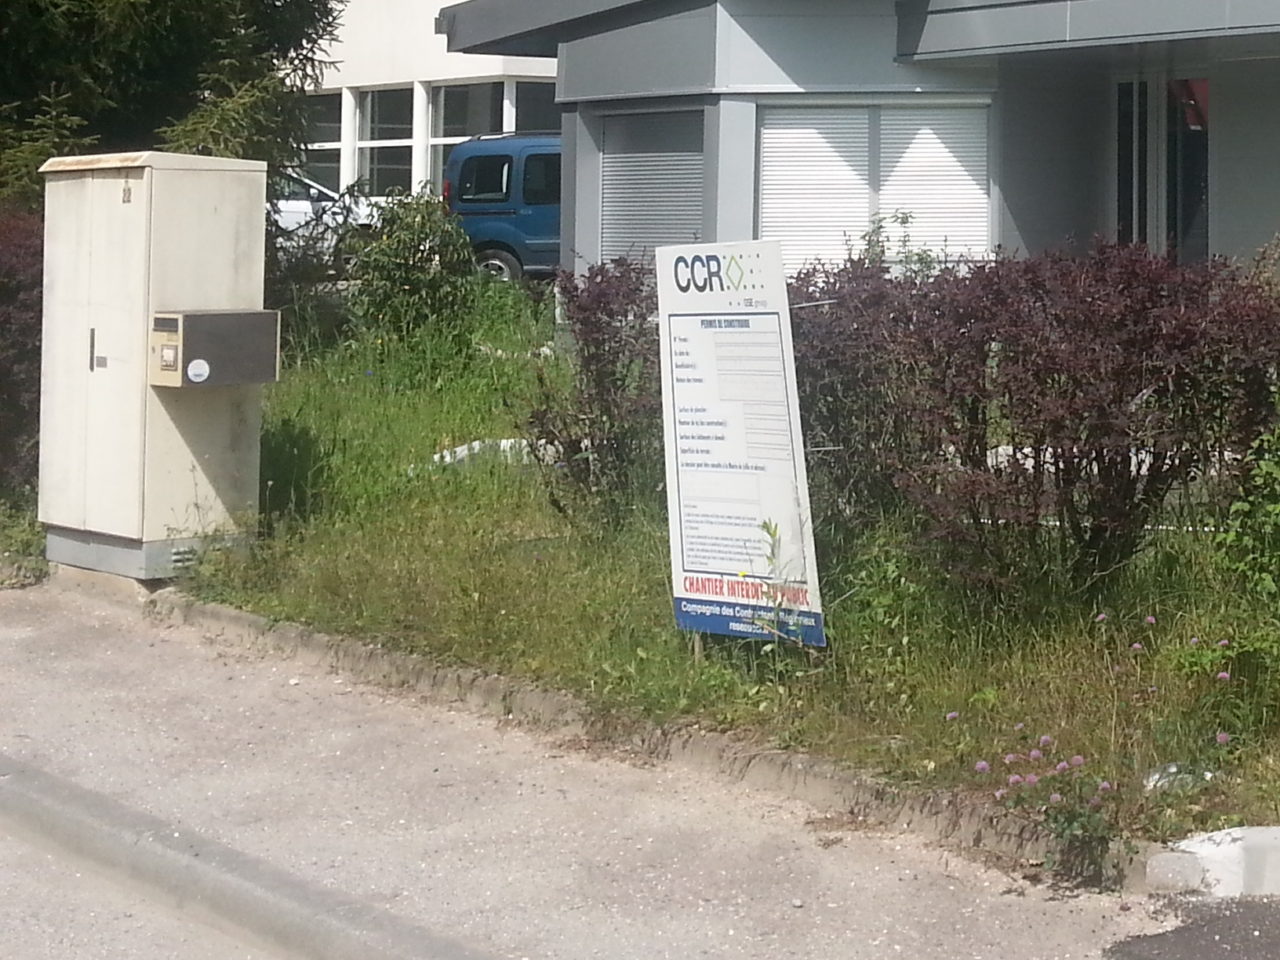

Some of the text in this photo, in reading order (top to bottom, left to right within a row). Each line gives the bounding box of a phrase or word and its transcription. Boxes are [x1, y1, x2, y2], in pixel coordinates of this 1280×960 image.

[674, 254, 725, 293] CCR
[683, 576, 725, 596] CHANTIER
[726, 579, 764, 600] INTERDIT
[681, 601, 720, 616] Compagnie
[721, 603, 734, 616] des
